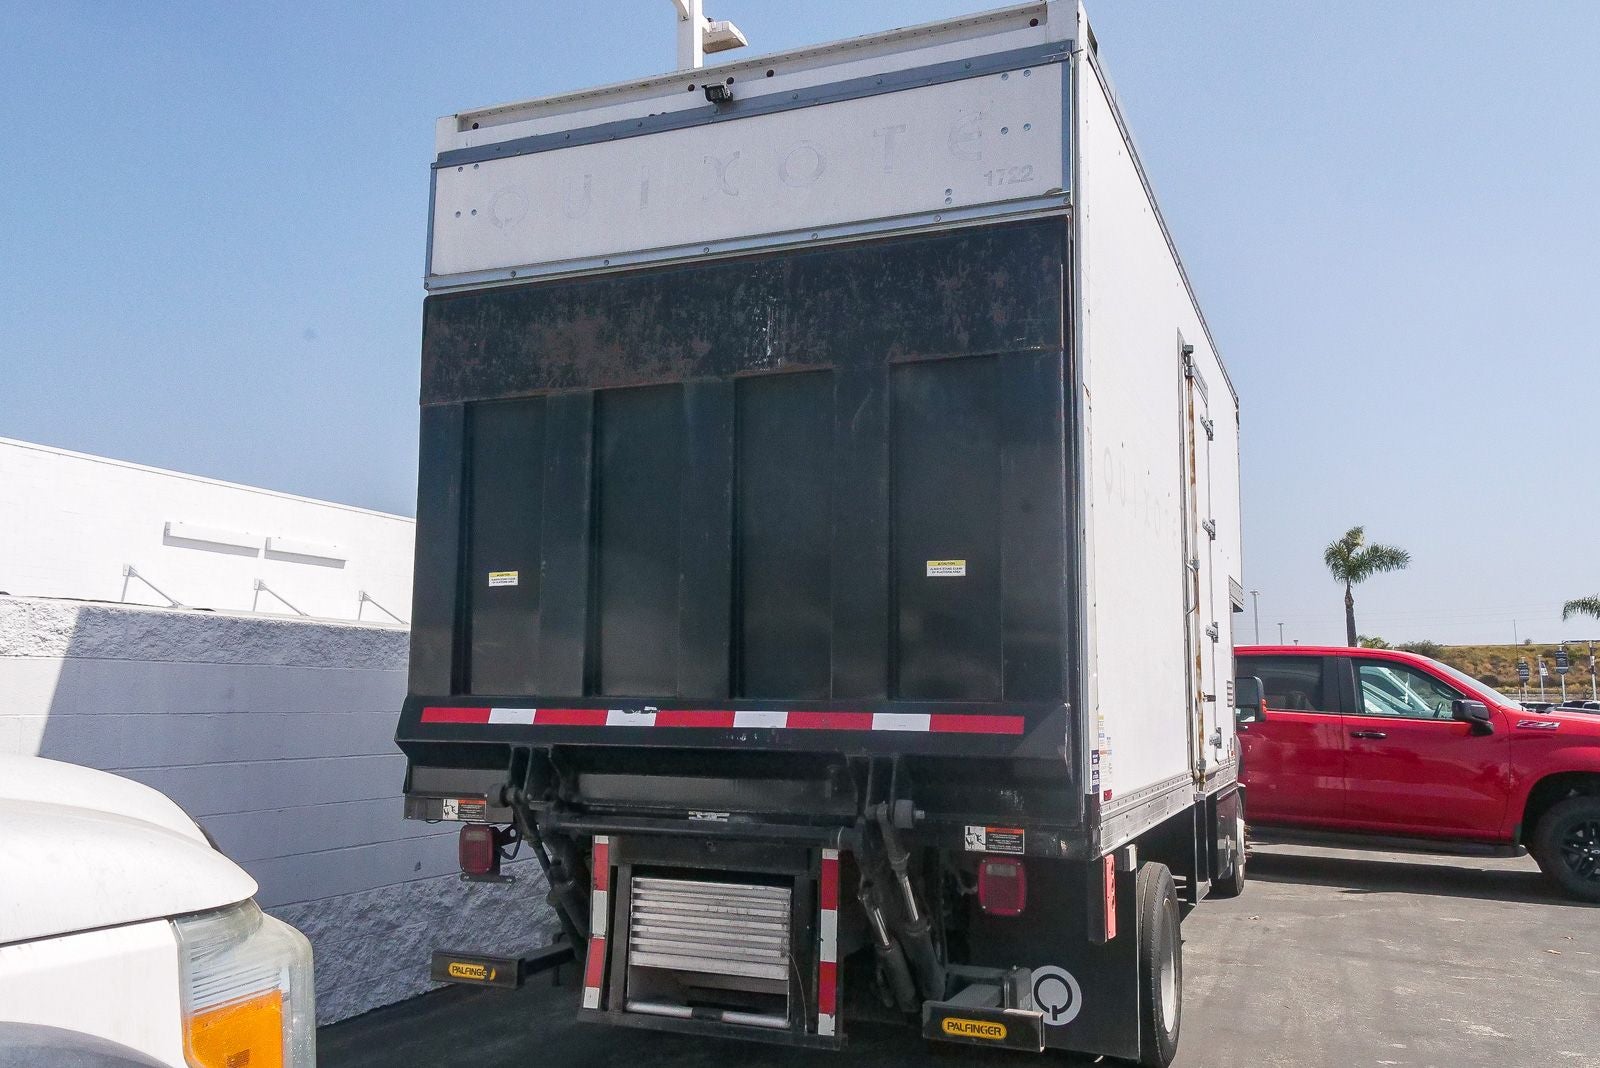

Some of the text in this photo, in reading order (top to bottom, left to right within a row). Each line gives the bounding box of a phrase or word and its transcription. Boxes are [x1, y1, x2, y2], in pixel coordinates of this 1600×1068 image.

[487, 109, 984, 231] QUIXOTE
[983, 164, 1034, 187] 1722
[451, 965, 489, 977] PALFINGE
[946, 1021, 1003, 1037] PALFINGER
